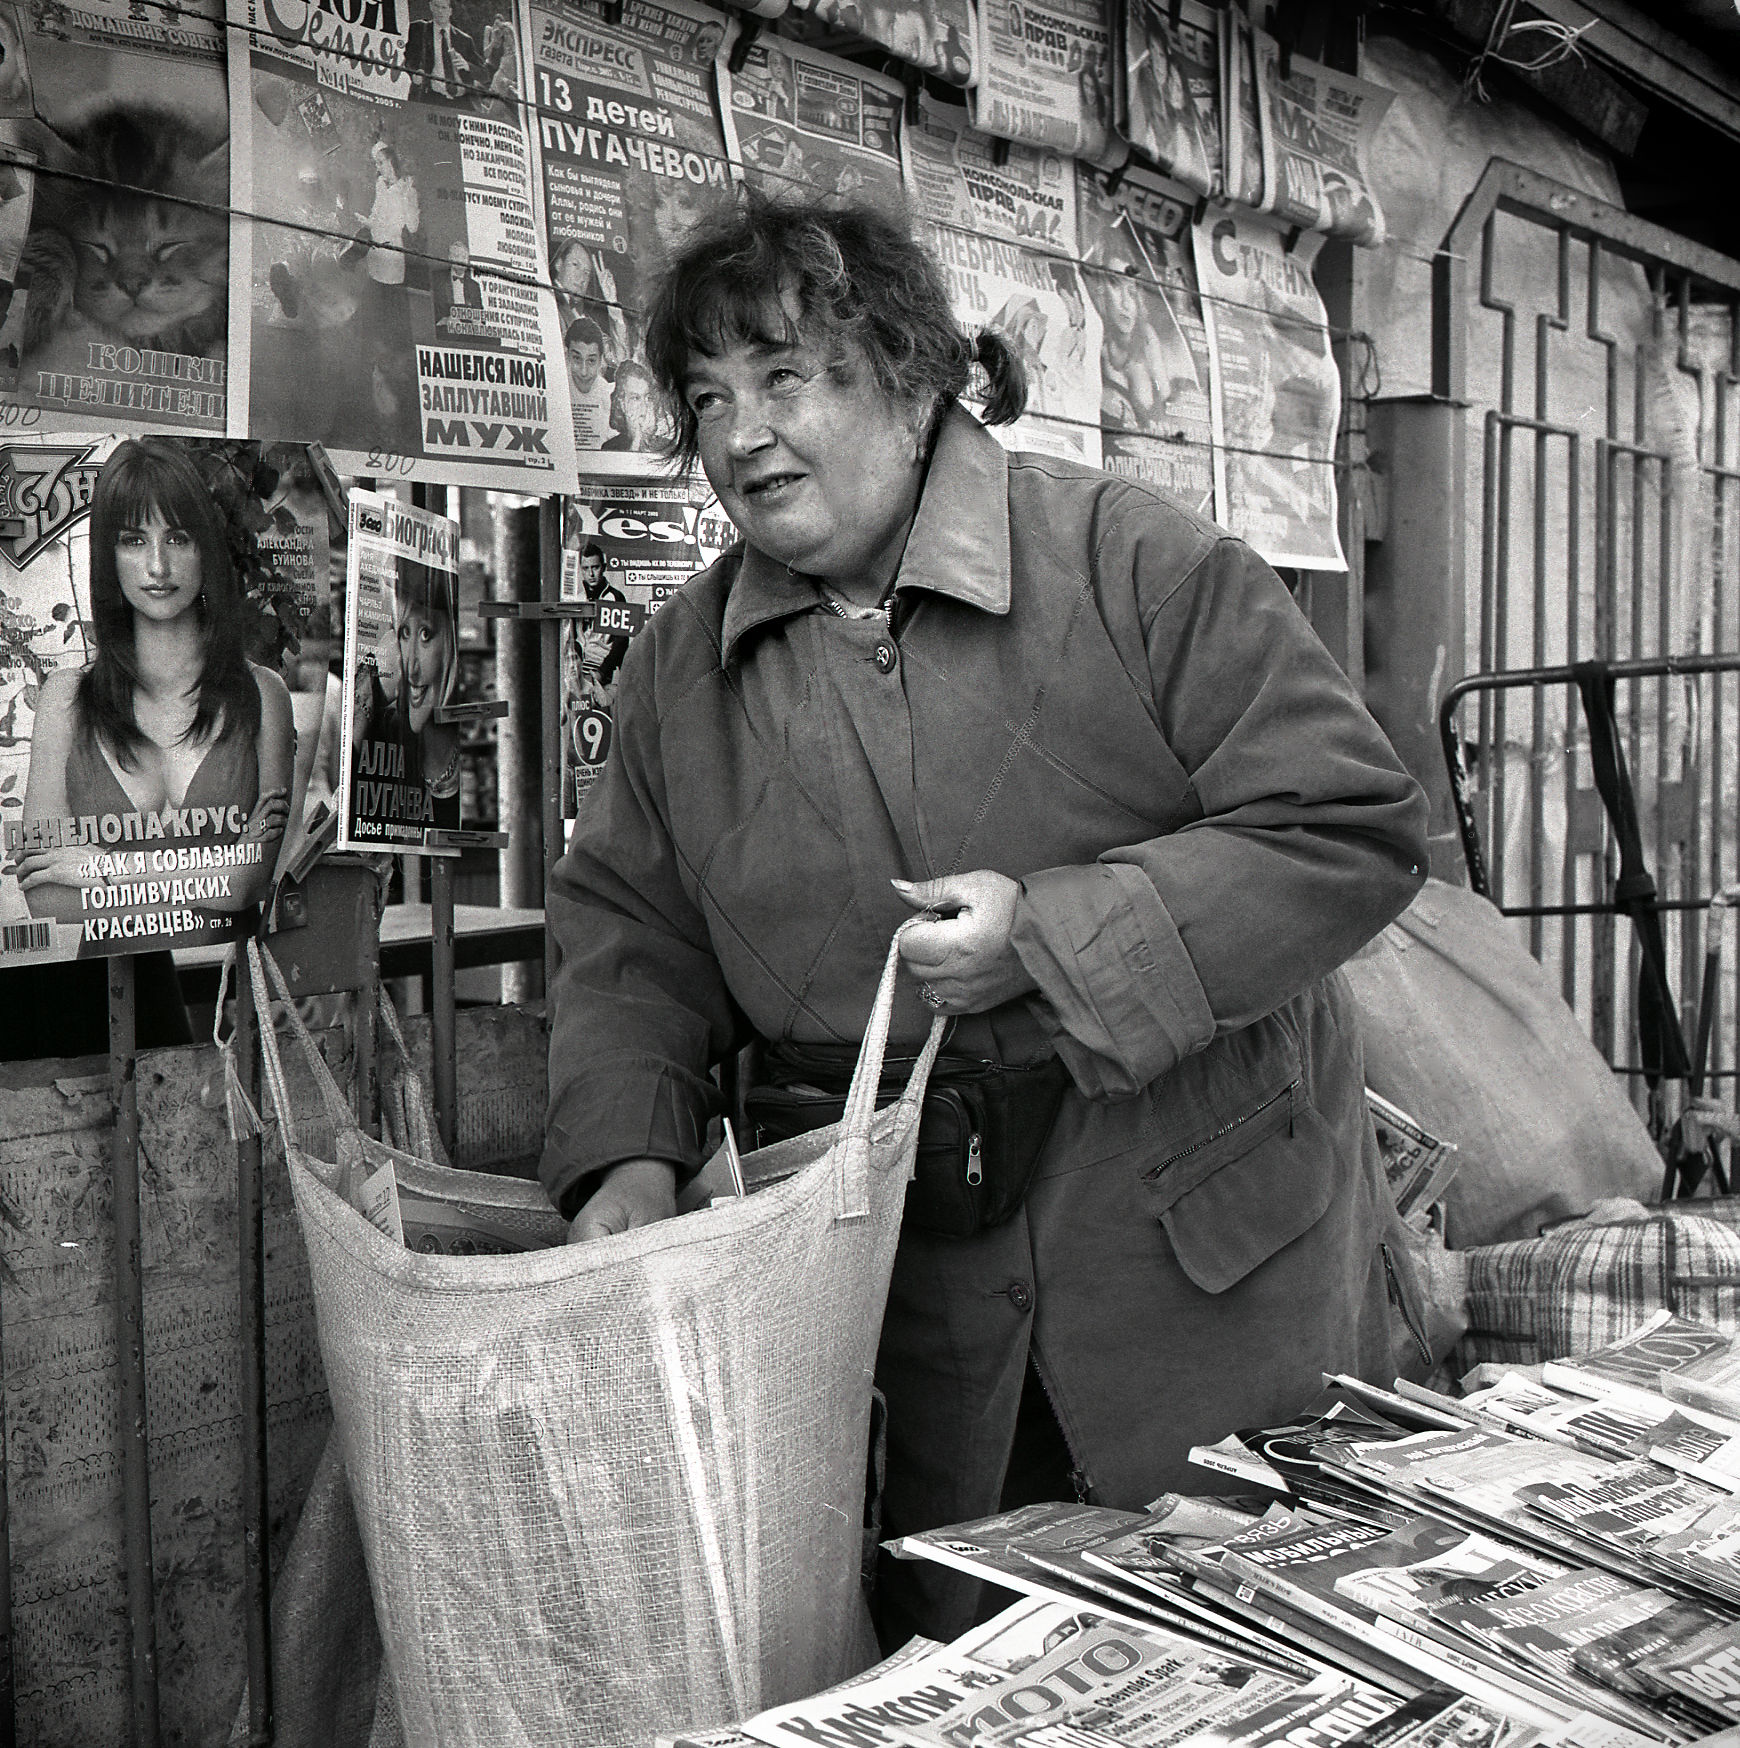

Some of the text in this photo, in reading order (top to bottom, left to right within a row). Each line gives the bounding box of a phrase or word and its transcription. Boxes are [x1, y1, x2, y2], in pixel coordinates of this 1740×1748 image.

[71, 9, 167, 42] ДОМАШНИЕ
[1023, 7, 1109, 44] КОМСОМОЛЬСКАЯ
[540, 43, 573, 68] газета
[543, 20, 635, 70] ЭКСПРЕСС
[319, 65, 345, 91] №14
[540, 72, 676, 138] 13 детей
[469, 120, 487, 132] НИМ
[463, 148, 475, 160] НО
[484, 166, 497, 179] ВСЕ
[547, 164, 621, 191] Как бы выглядели
[481, 194, 507, 208] МОЕМУ
[549, 181, 584, 197] сыновья
[593, 190, 621, 205] дочери
[962, 167, 1064, 211] КОМСОМОЛЬСКАЯ
[551, 194, 623, 218] Аллы, родись они
[552, 211, 563, 221] от
[564, 214, 575, 223] ее
[576, 214, 605, 229] мужей
[552, 225, 606, 243] любовников
[450, 307, 500, 323] ОТНОШЕНИЯ
[487, 296, 498, 308] НЕ
[87, 342, 224, 385] КОШКИ
[419, 349, 547, 389] НАШЕЛСЯ МОЙ
[422, 383, 548, 422] ЗАПЛУТАВШИЙ
[426, 418, 551, 454] МУЖ
[611, 488, 640, 500] ЗВЕЗД»
[641, 490, 648, 499] И
[649, 490, 659, 499] НЕ
[660, 490, 687, 500] ТОЛЬКО
[573, 503, 698, 545] Yes!
[257, 538, 314, 553] АЛЕКСАНДРА
[272, 551, 314, 566] БУЙНОВА
[638, 573, 646, 581] ТЫ
[647, 574, 673, 582] СЛЫШИШЬ
[359, 596, 383, 610] ЧАРЛЬЗ
[600, 607, 635, 633] ВСЕ,
[582, 716, 604, 760] 9
[357, 739, 406, 779] АЛЛА
[576, 767, 591, 778] ОЧЕНЬ
[355, 780, 435, 823] ПУГАЧЕВА
[4, 804, 250, 850] ПЕНЕЛОПА КРУС:
[354, 817, 423, 840] Досье примадонны
[79, 841, 263, 879] «КАК Я СОБЛАЗНЯЛА
[81, 875, 232, 911] ГОЛЛИВУДСКИХ
[84, 909, 205, 943] КРАСАВЦЕВ»
[209, 918, 225, 930] СТР.
[1203, 1457, 1238, 1473] АПРЕЛЬ 2005
[1243, 1524, 1388, 1566] МОБИЛЬНЫЕ
[1487, 1604, 1549, 1628] Все
[1548, 1573, 1630, 1616] красоте
[1094, 1655, 1186, 1709] Chevrolet Spark
